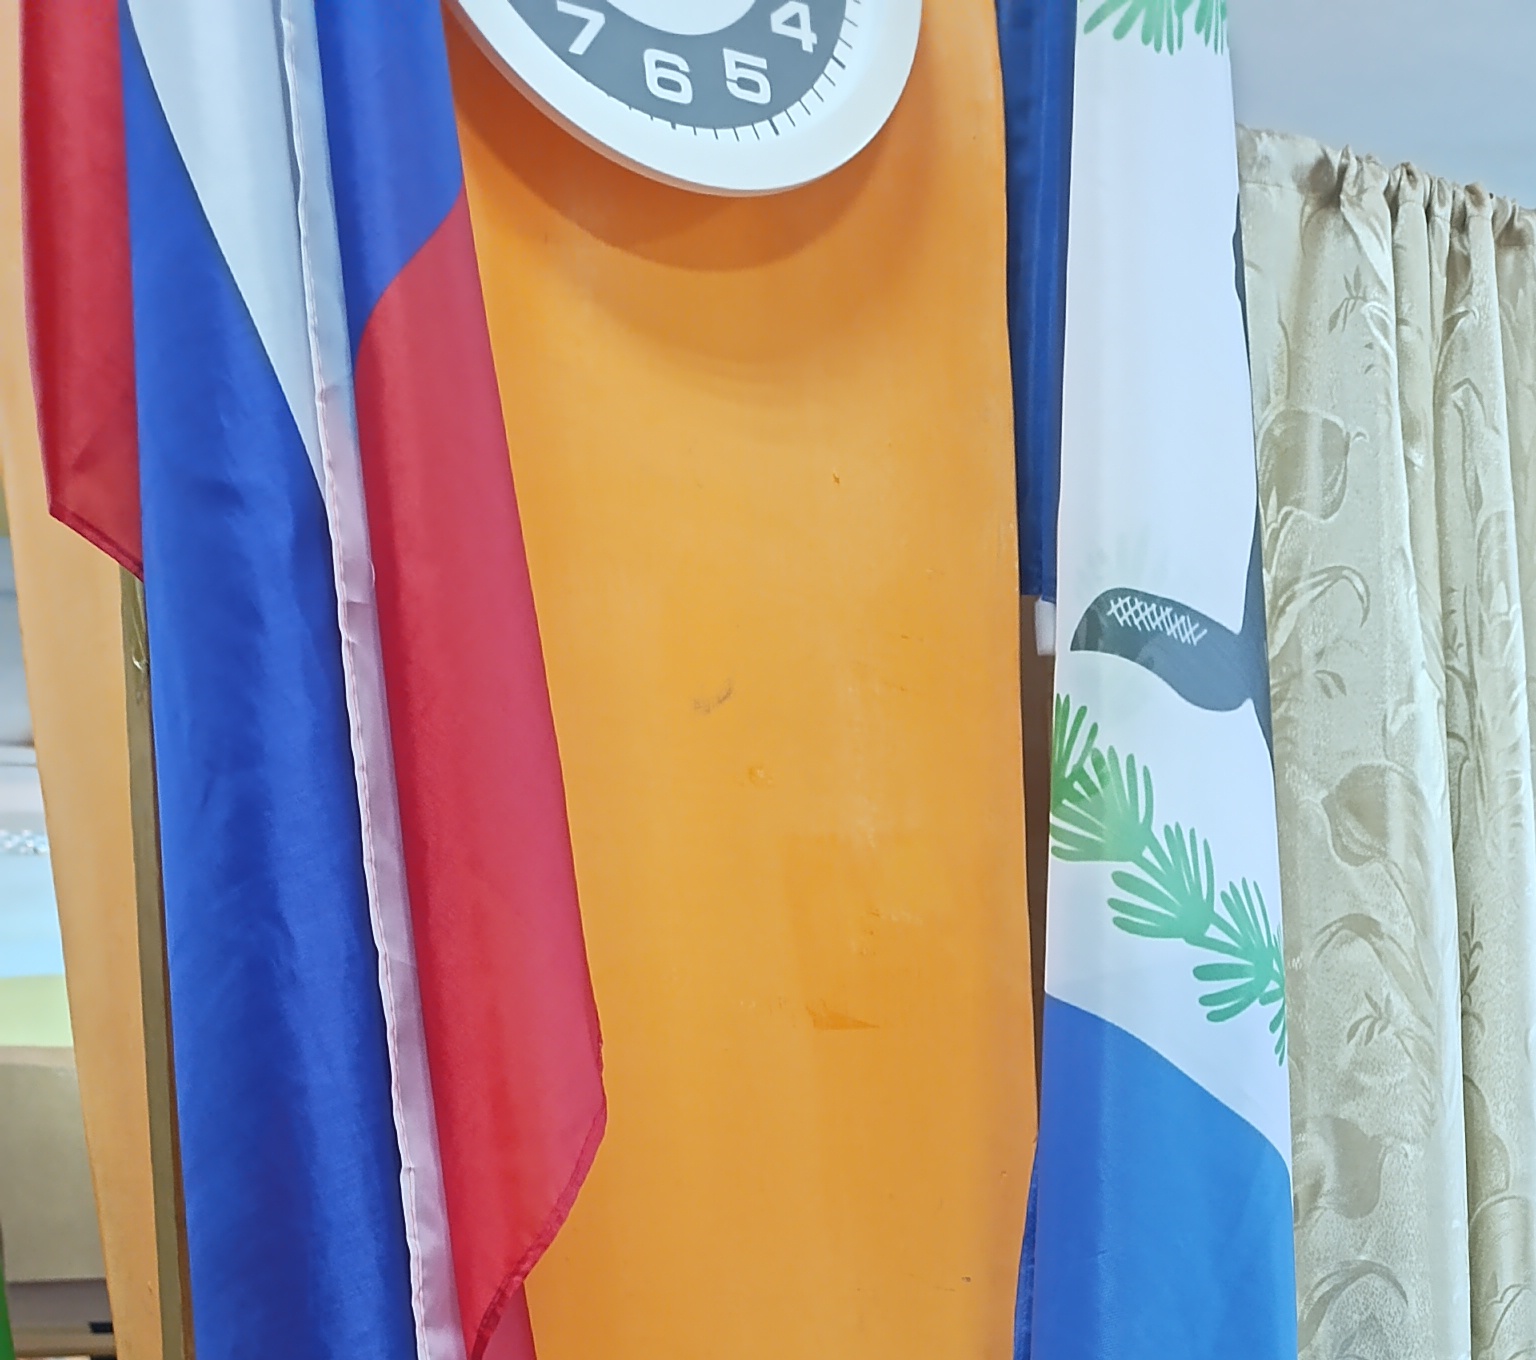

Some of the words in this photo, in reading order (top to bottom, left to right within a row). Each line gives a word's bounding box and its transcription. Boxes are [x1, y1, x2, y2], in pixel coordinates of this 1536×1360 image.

[556, 0, 606, 55] 7
[769, 0, 818, 53] 4
[643, 48, 693, 105] 6
[722, 47, 772, 105] 5
